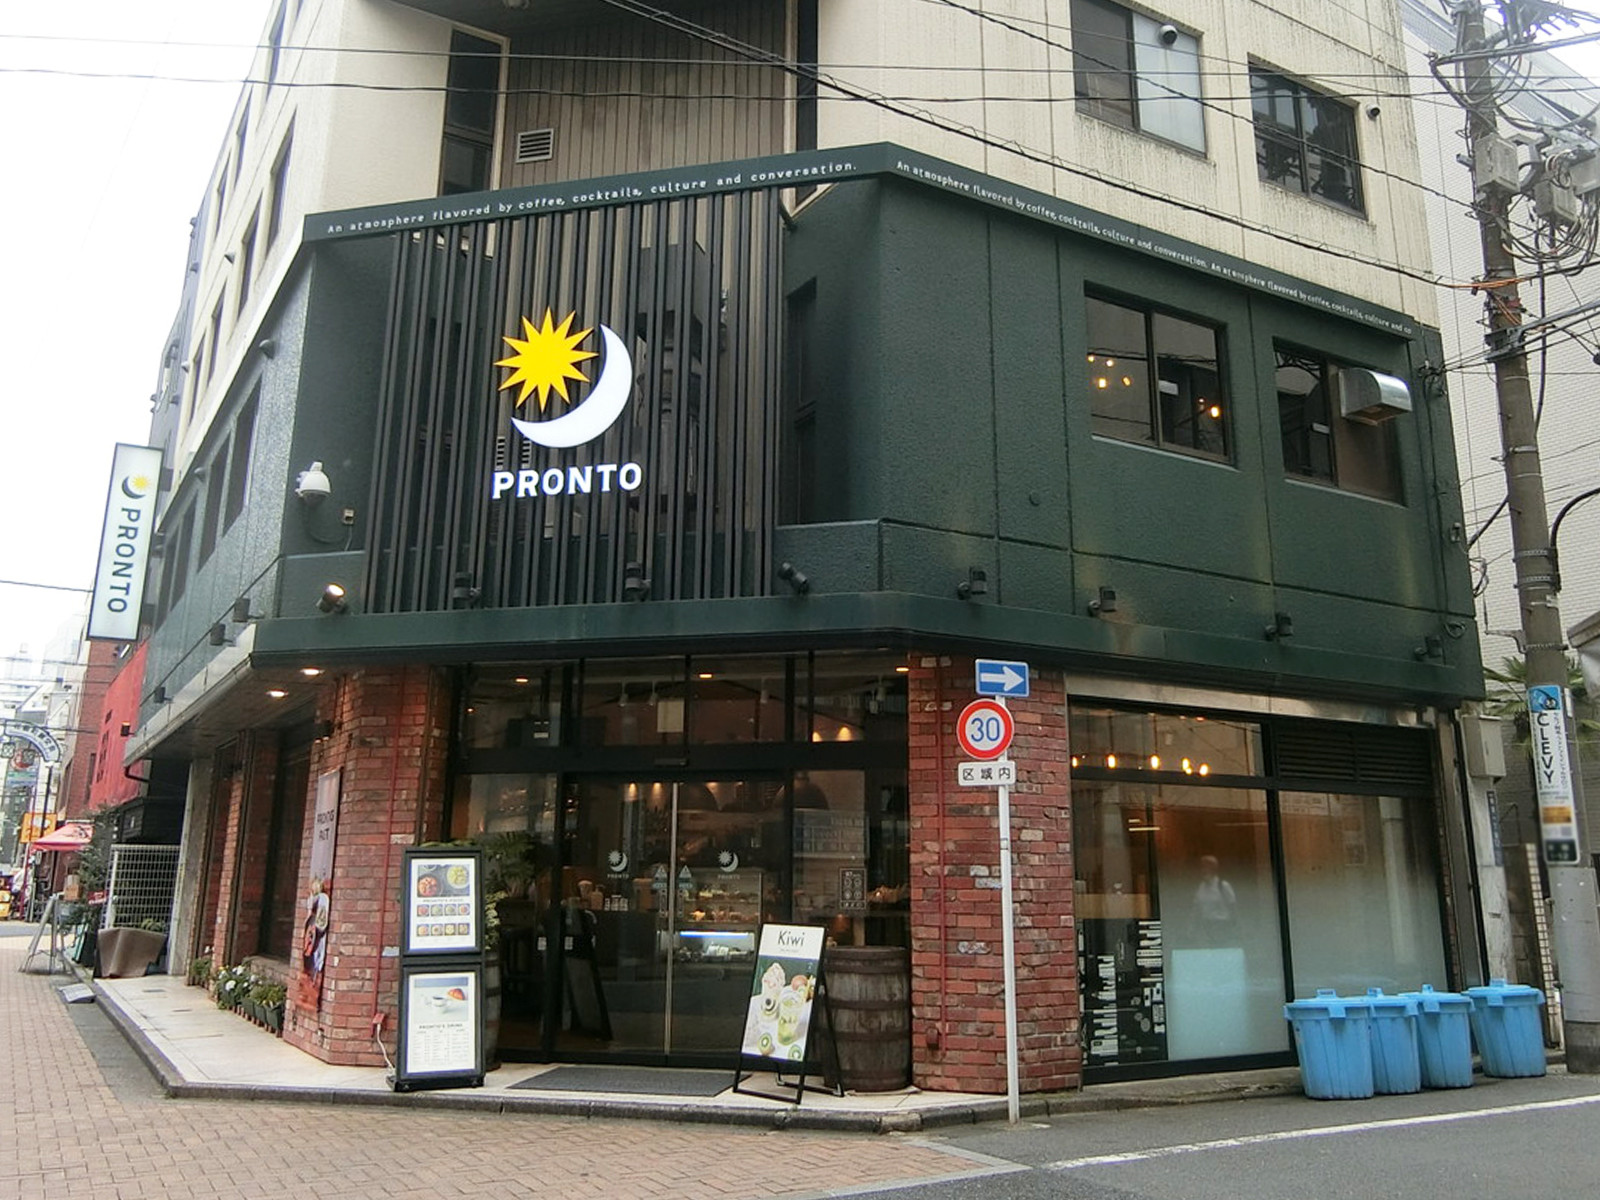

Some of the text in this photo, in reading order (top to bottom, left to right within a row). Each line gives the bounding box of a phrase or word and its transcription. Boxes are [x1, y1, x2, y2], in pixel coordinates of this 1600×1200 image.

[327, 224, 343, 233] An
[350, 213, 425, 231] atmosphere
[433, 204, 491, 220] flavored
[499, 202, 513, 214] by
[572, 186, 642, 203] cocktails,
[650, 179, 707, 194] culture
[717, 174, 742, 186] and
[751, 161, 857, 182] conversation.
[896, 160, 910, 173] An
[912, 167, 970, 192] atmosphere
[973, 184, 1013, 205] flavored
[1015, 198, 1026, 211] by
[1102, 227, 1135, 245] culture
[1137, 238, 1152, 250] and
[1154, 244, 1208, 269] conversation.
[1211, 261, 1222, 273] An
[1267, 279, 1298, 298] flavored
[1299, 289, 1308, 301] by
[1391, 320, 1403, 332] and
[492, 462, 642, 499] PRONTO
[107, 507, 141, 613] PRONTO
[970, 717, 1000, 742] 30
[1536, 712, 1555, 784] CLEVY
[962, 767, 1011, 781] 区域内
[777, 930, 806, 947] Kiwi
